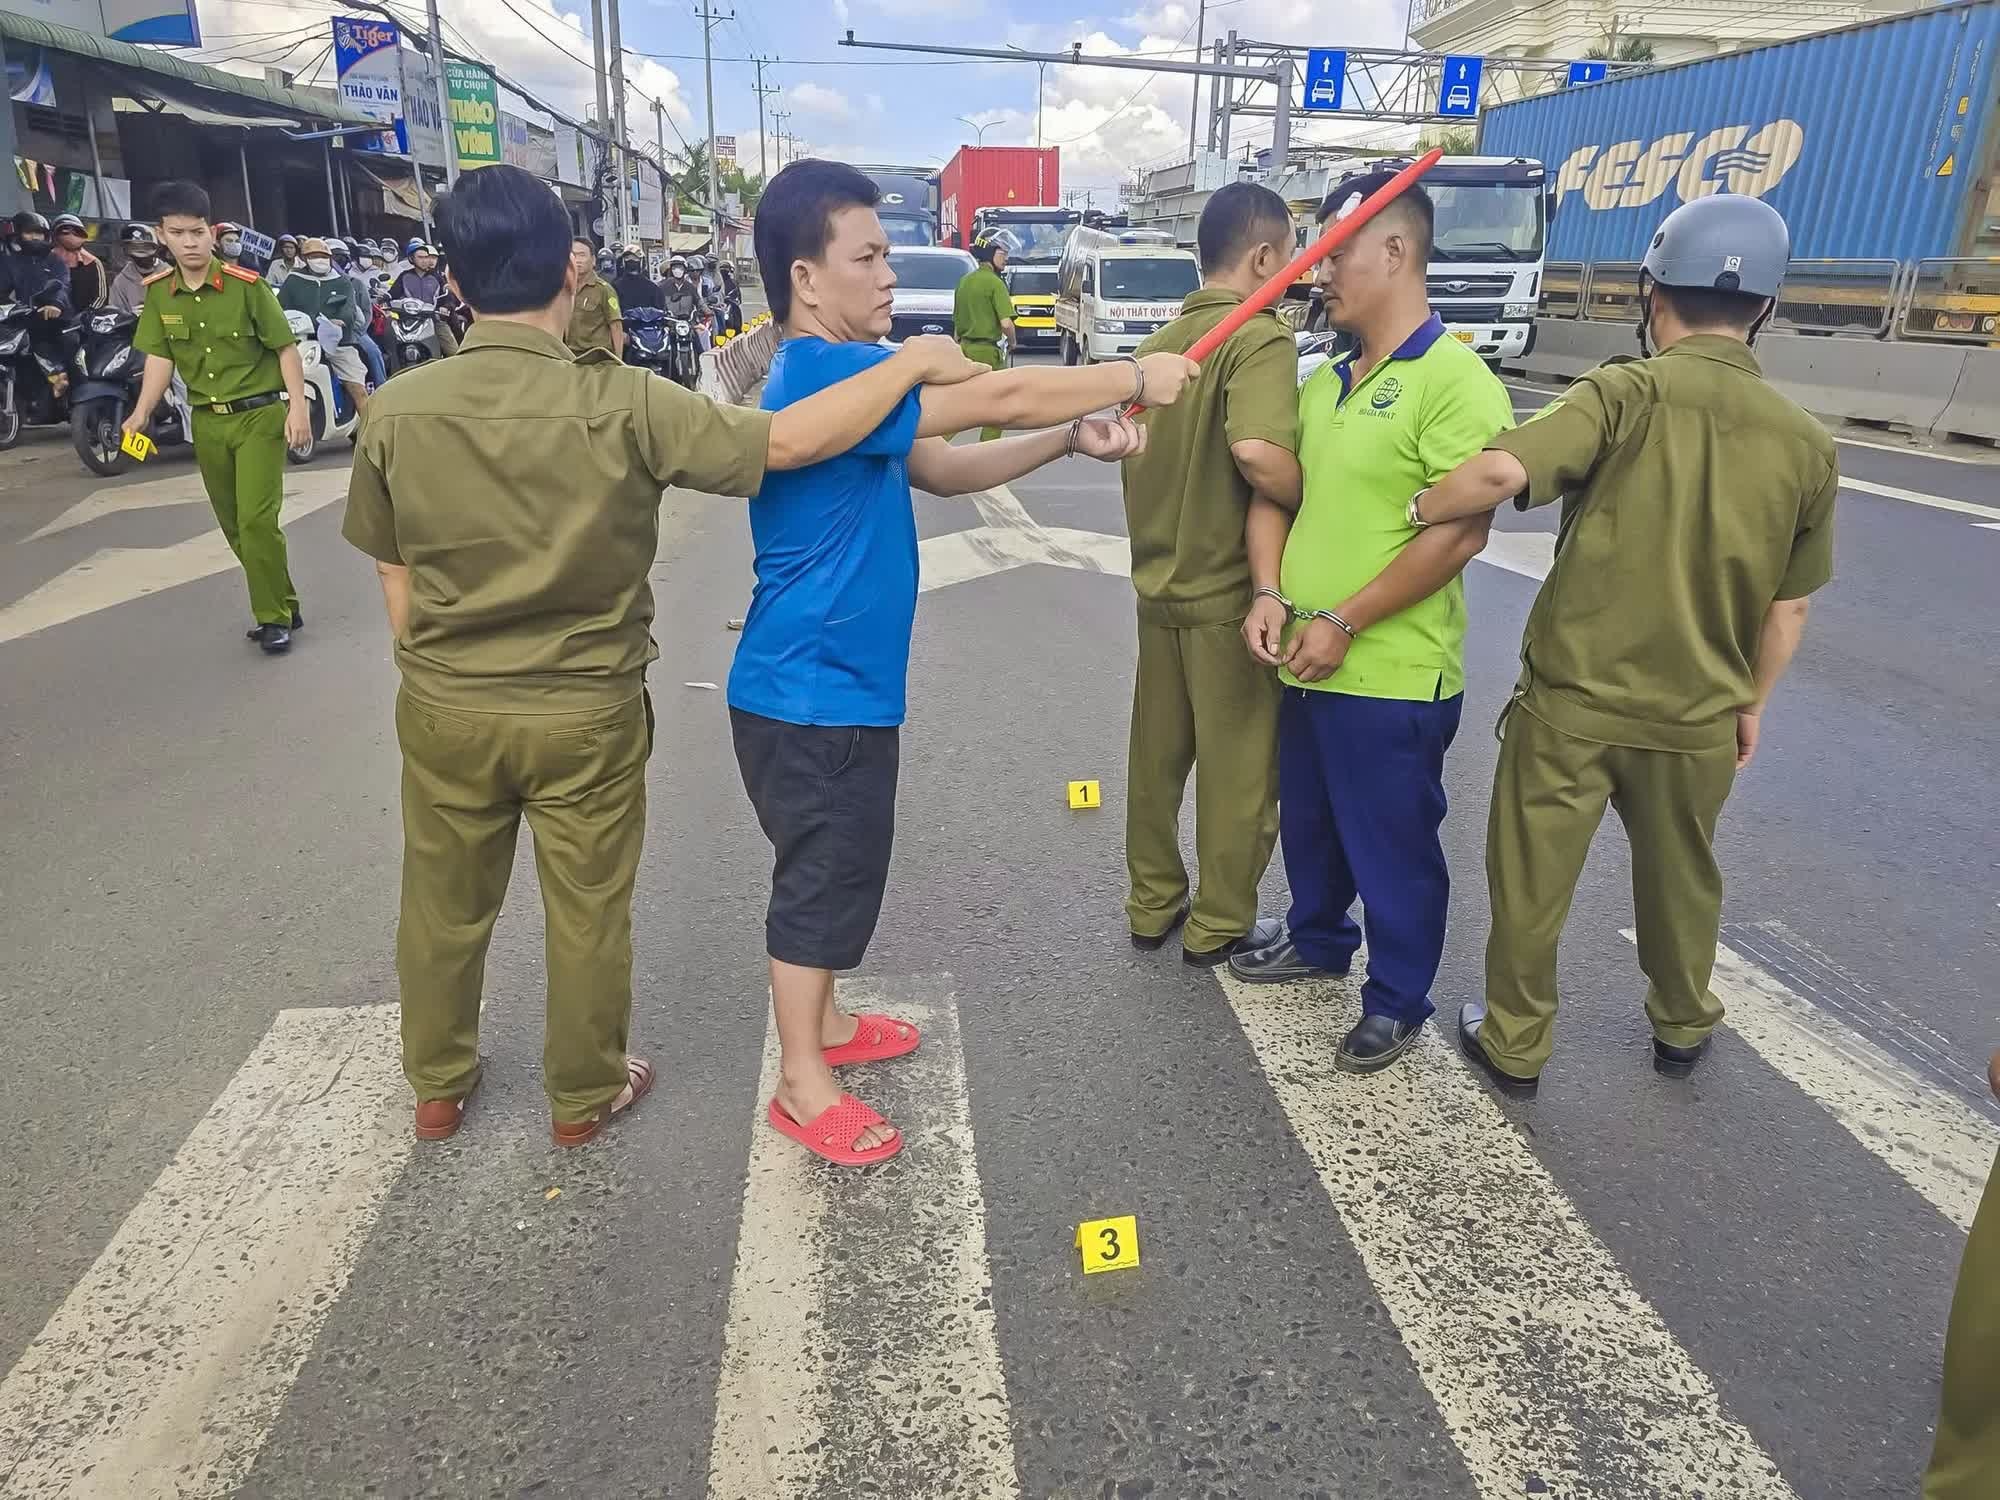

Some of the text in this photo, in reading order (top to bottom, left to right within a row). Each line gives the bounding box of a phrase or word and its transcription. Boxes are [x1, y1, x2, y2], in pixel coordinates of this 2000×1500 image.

[352, 24, 393, 47] Tiger
[343, 82, 372, 99] THẢO
[464, 80, 487, 91] CHỌN
[449, 93, 495, 125] THẢO
[456, 126, 494, 155] VÂN
[1550, 119, 1803, 210] FESCO
[1110, 305, 1124, 319] NỘI
[130, 434, 144, 452] 10
[1080, 785, 1088, 802] 1
[1100, 1228, 1120, 1261] 3
